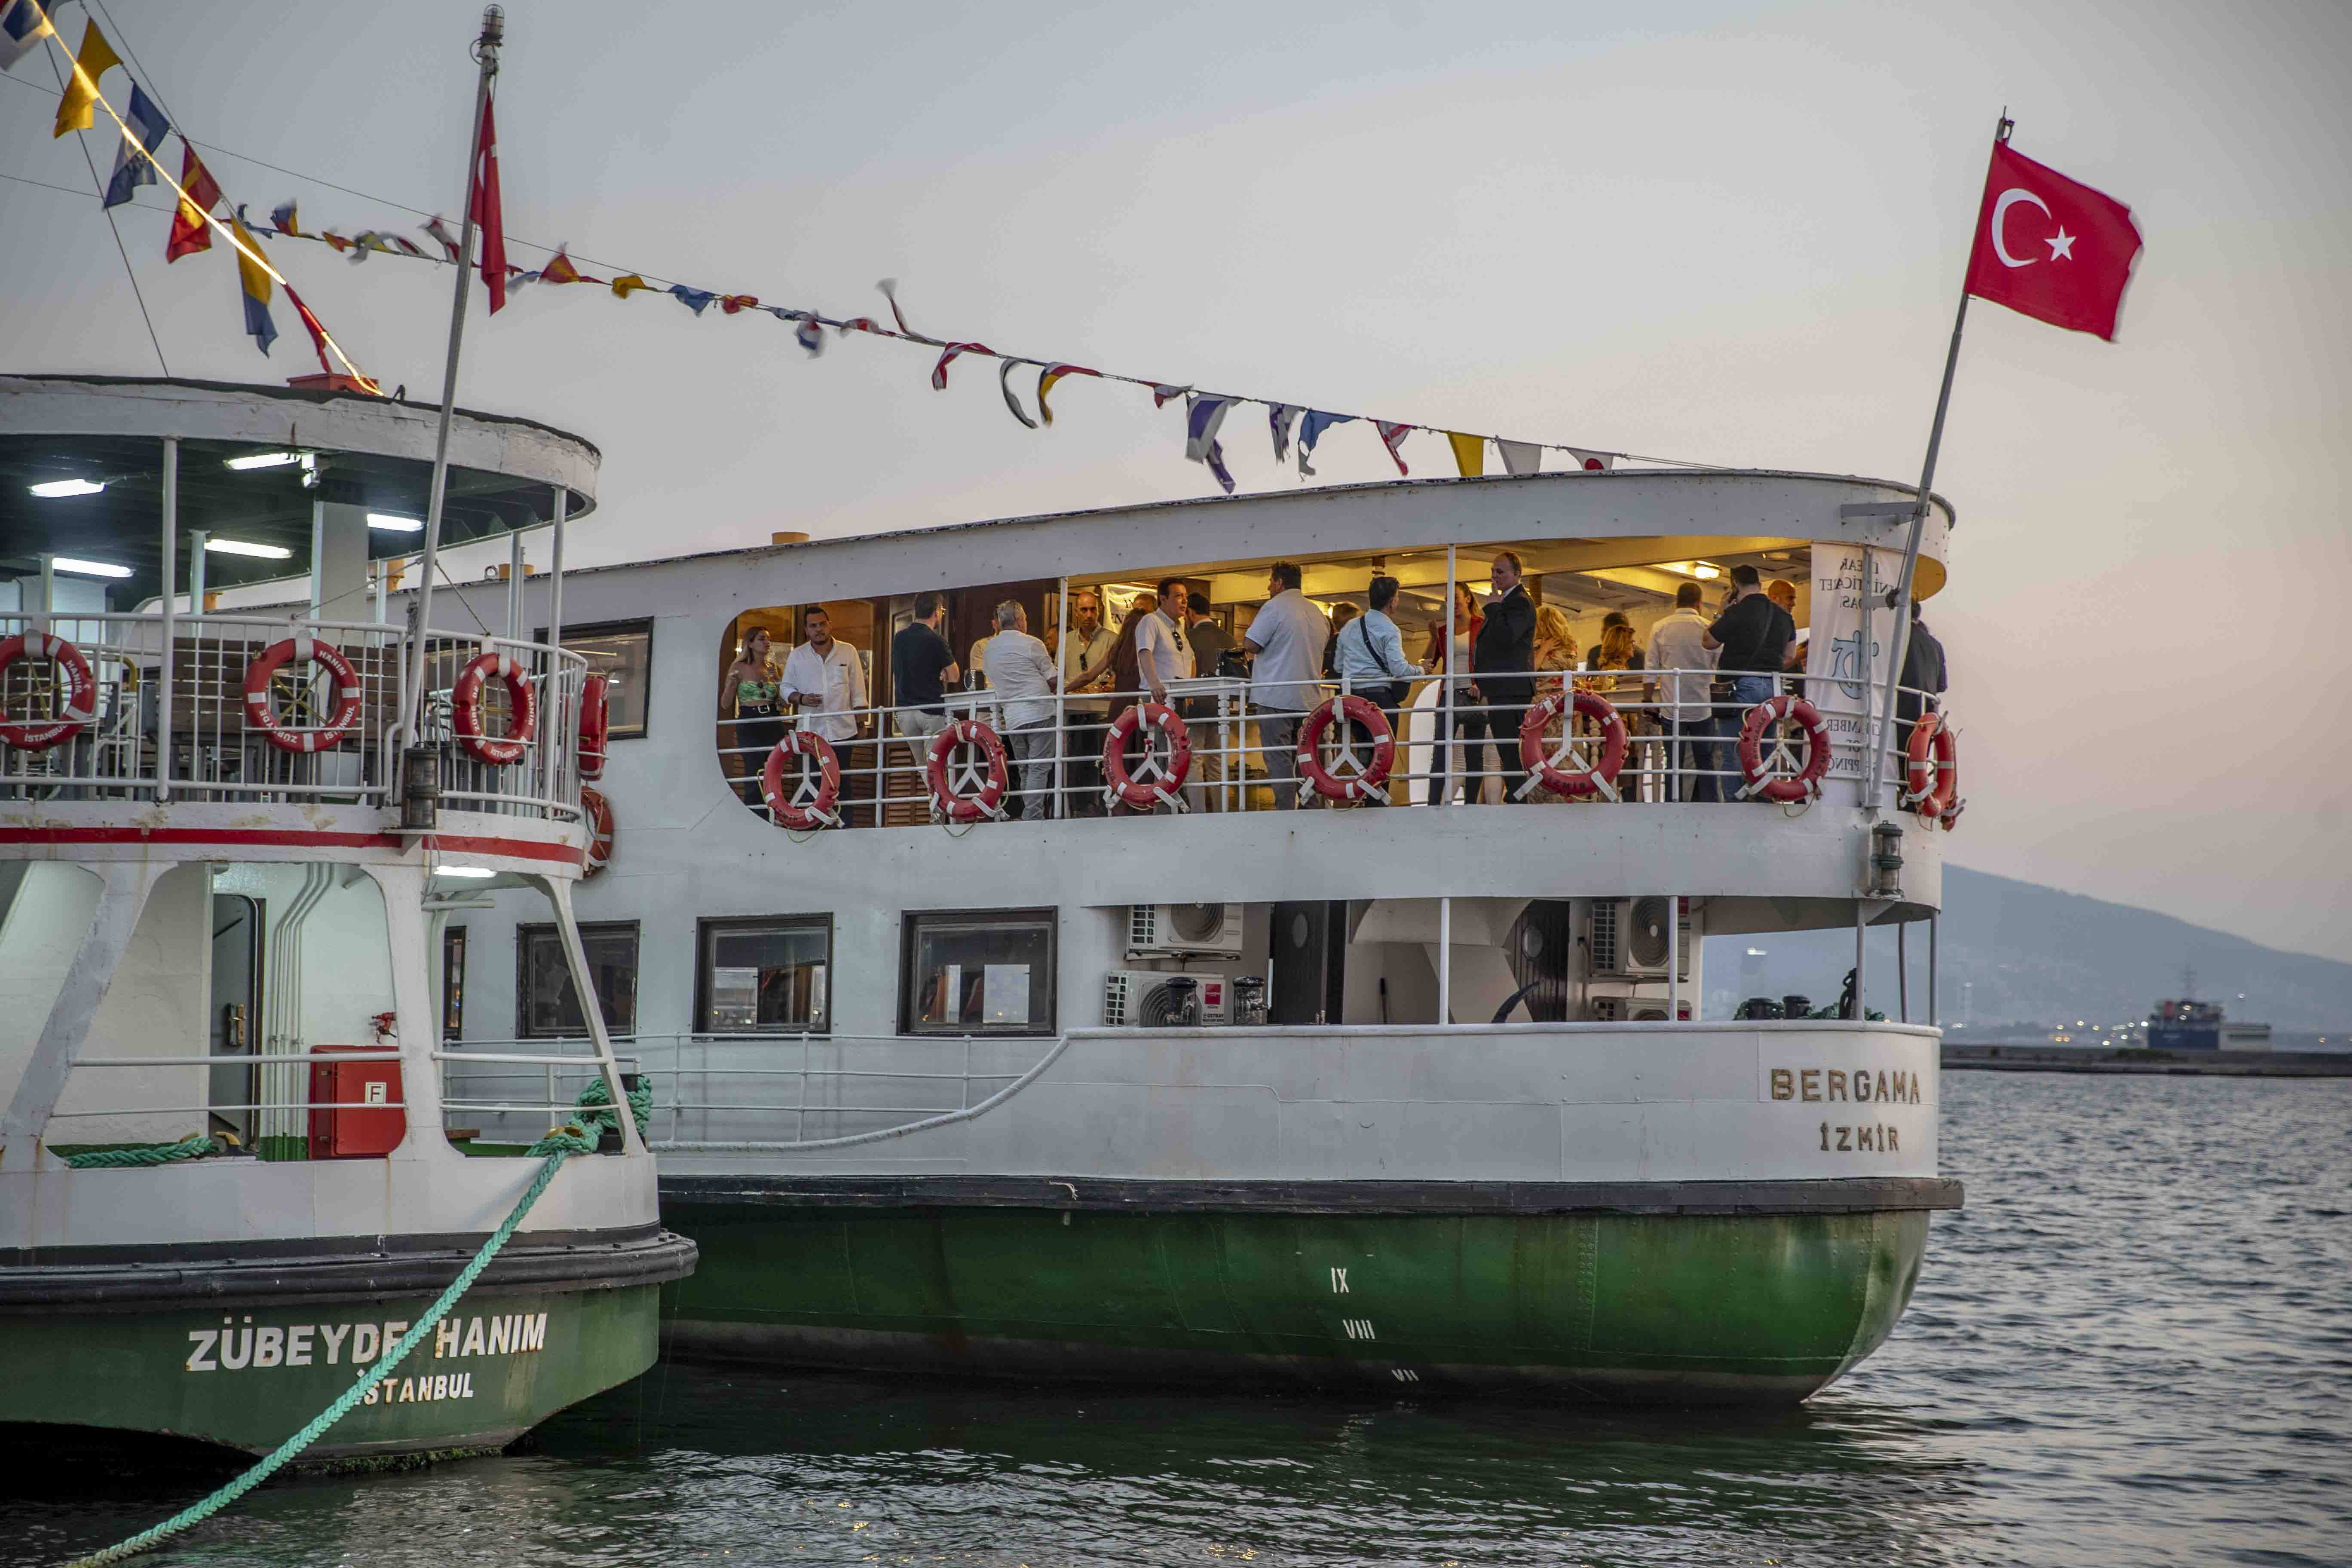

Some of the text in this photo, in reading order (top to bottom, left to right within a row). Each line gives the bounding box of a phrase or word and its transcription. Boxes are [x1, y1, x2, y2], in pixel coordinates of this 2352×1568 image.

[318, 650, 347, 676] HANIM
[66, 660, 83, 693] HANIM
[370, 1085, 382, 1102] F
[1771, 1069, 1920, 1104] BERGAMA
[1820, 1121, 1899, 1152] İZMİR
[1331, 1267, 1349, 1293] IX
[434, 1313, 547, 1359] HANIM
[1342, 1319, 1375, 1340] VIII
[1391, 1369, 1419, 1382] VII
